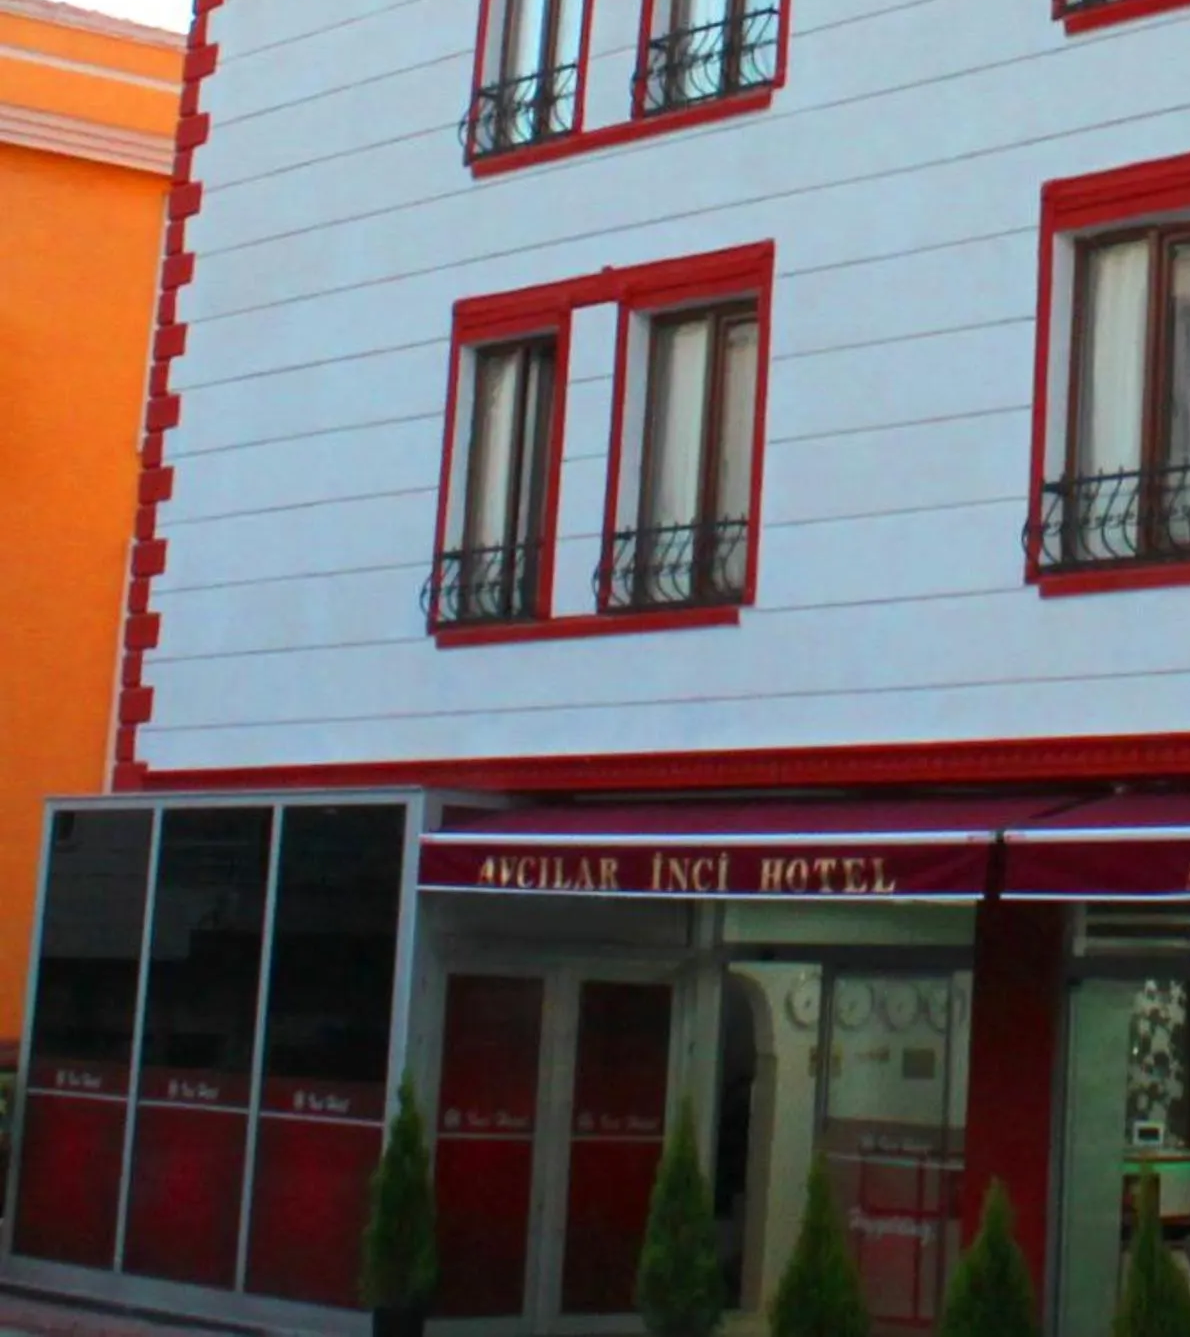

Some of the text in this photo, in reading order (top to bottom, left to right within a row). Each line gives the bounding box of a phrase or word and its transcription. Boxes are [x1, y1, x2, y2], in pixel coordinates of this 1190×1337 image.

[479, 851, 896, 894] AVCILAR İNCİ HOTEL
